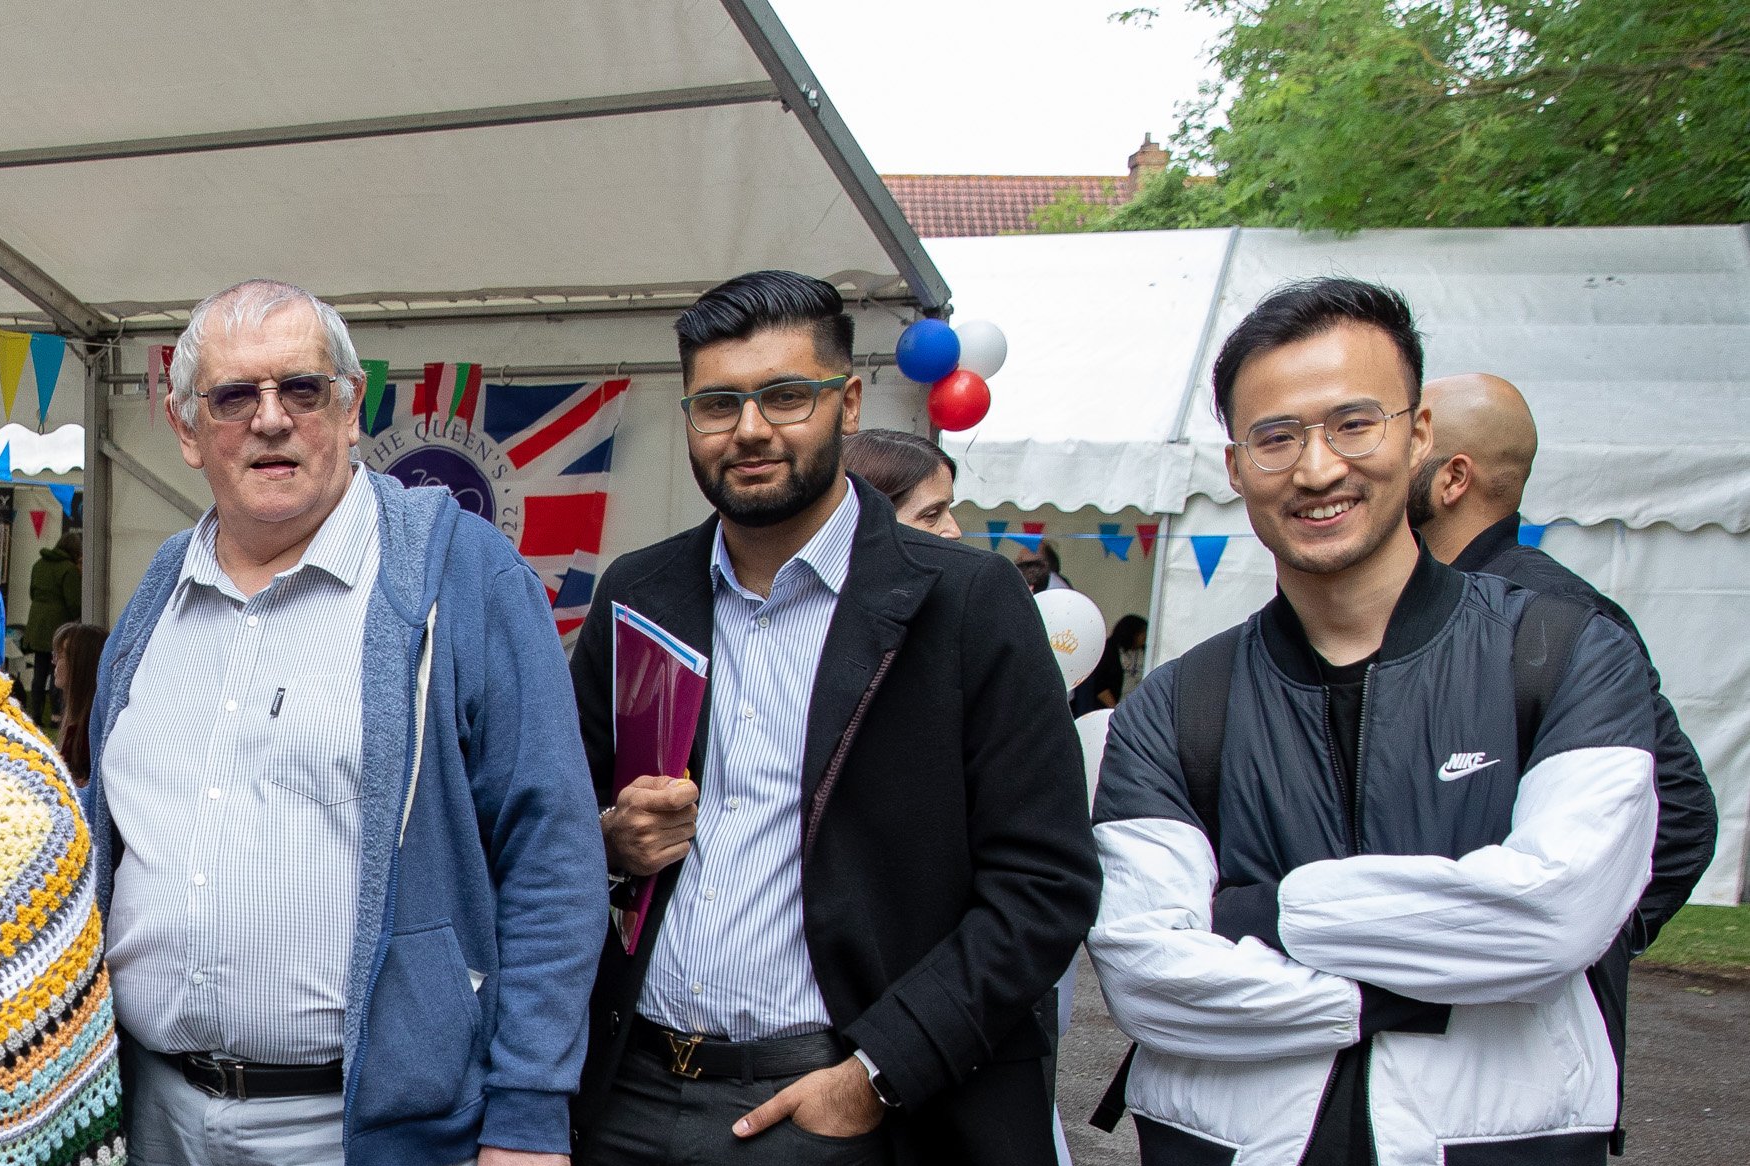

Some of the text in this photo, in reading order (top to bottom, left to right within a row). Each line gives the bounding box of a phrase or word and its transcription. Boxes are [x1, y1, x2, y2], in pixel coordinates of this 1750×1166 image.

[364, 420, 508, 480] THE QUEEN'S
[1445, 752, 1486, 770] NIKE
